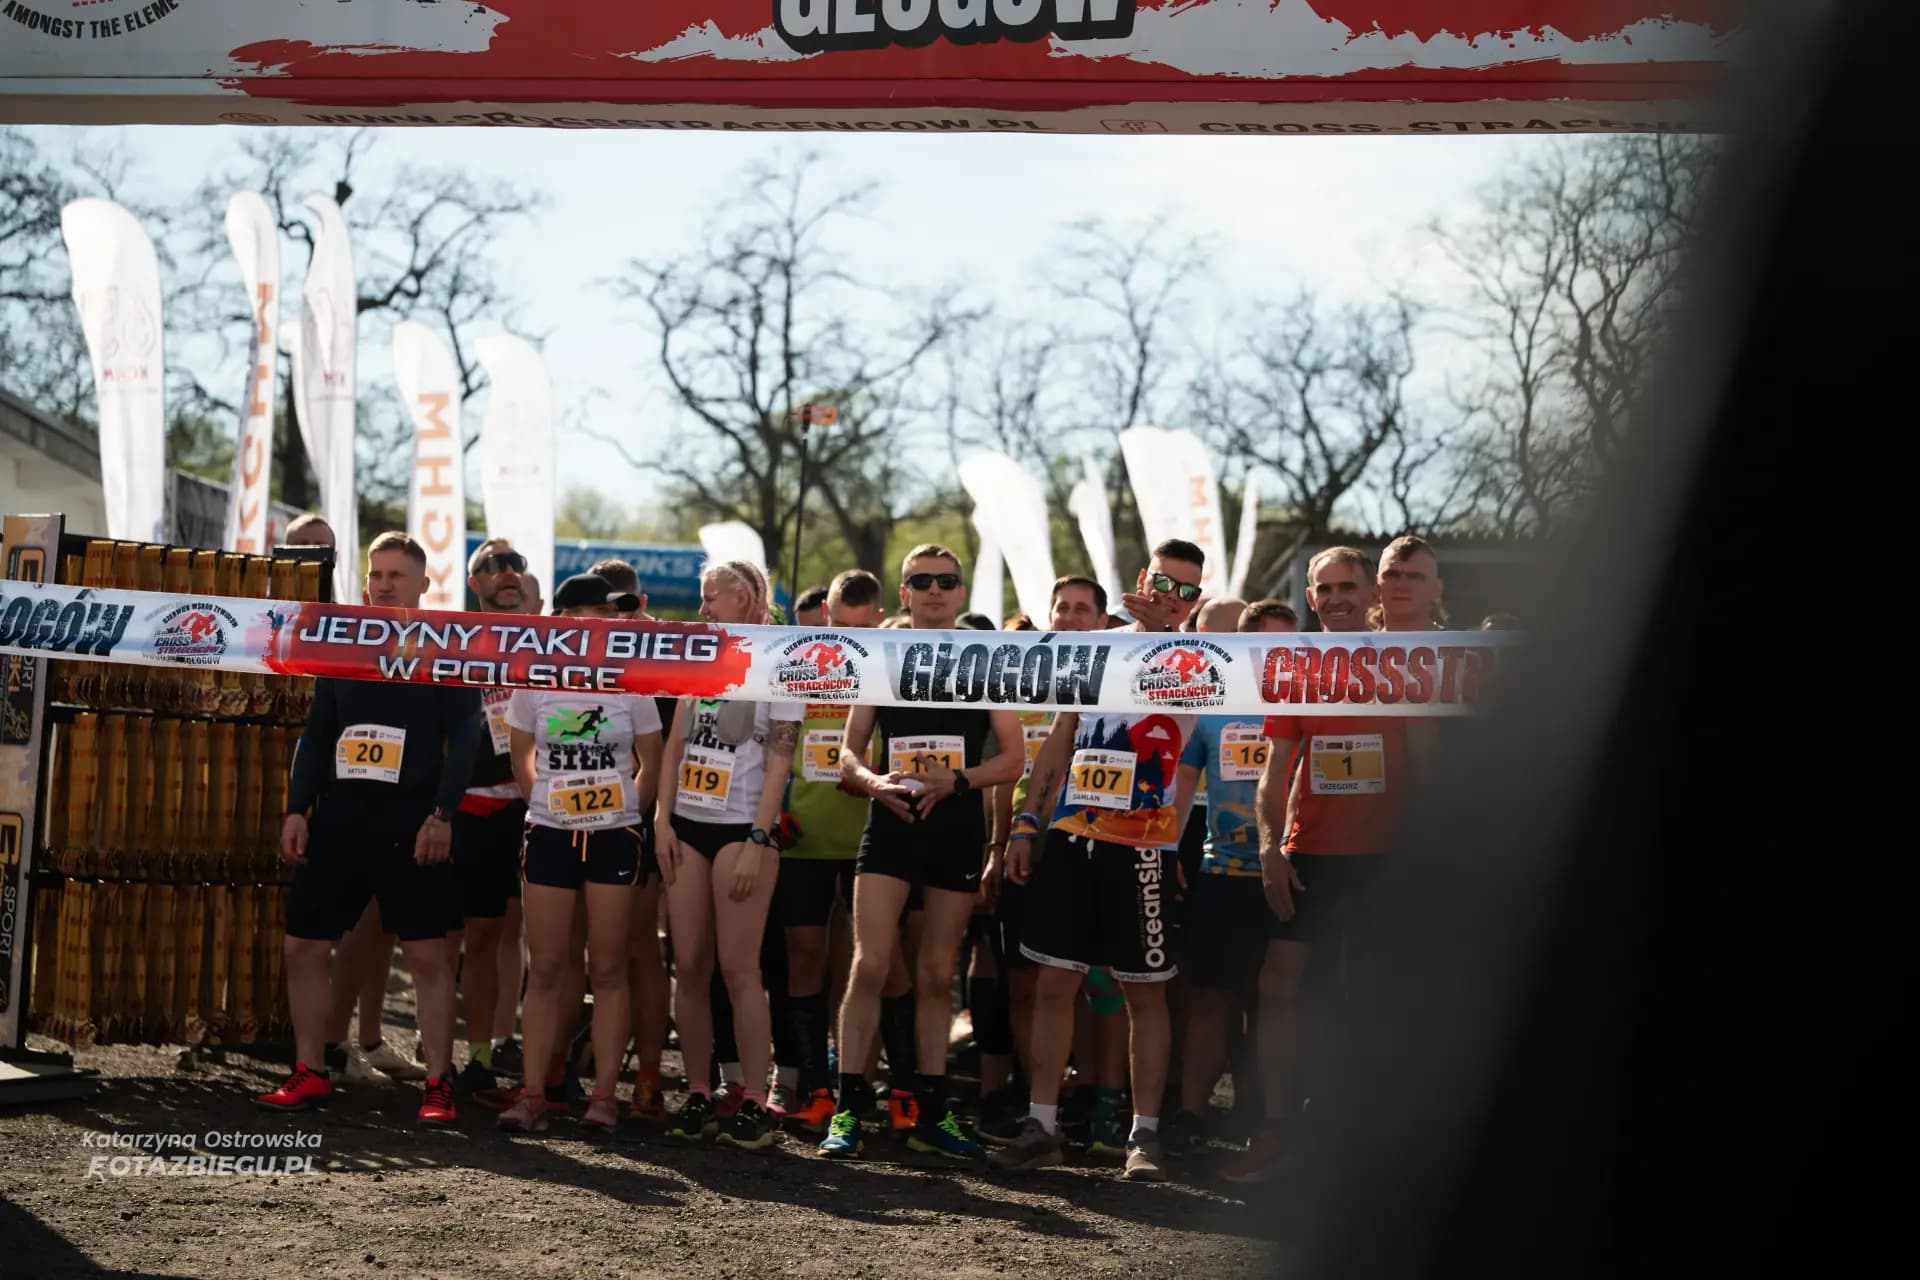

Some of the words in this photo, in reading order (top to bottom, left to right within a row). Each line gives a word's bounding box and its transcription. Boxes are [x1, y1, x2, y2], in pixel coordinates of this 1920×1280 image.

[2, 0, 85, 39] AMONGST
[90, 17, 121, 38] THE
[154, 637, 191, 647] CROSS
[300, 616, 483, 651] JEDYNY
[491, 625, 590, 657] TAKI
[605, 630, 719, 662] BIEG
[379, 655, 420, 681] W
[432, 657, 626, 692] POLSCE
[779, 667, 817, 682] CROSS
[900, 632, 1111, 705] GŁOGÓW
[1140, 676, 1180, 691] CROSS
[356, 742, 384, 764] 20
[549, 750, 616, 770] SIŁA
[1241, 745, 1267, 764] 16
[1342, 755, 1353, 777] 1
[685, 767, 719, 790] 119
[1081, 767, 1122, 790] 107
[570, 788, 615, 811] 122
[1072, 793, 1101, 802] DAMIAN
[562, 814, 605, 825] AGNIESZKA
[1, 886, 16, 956] SPORT
